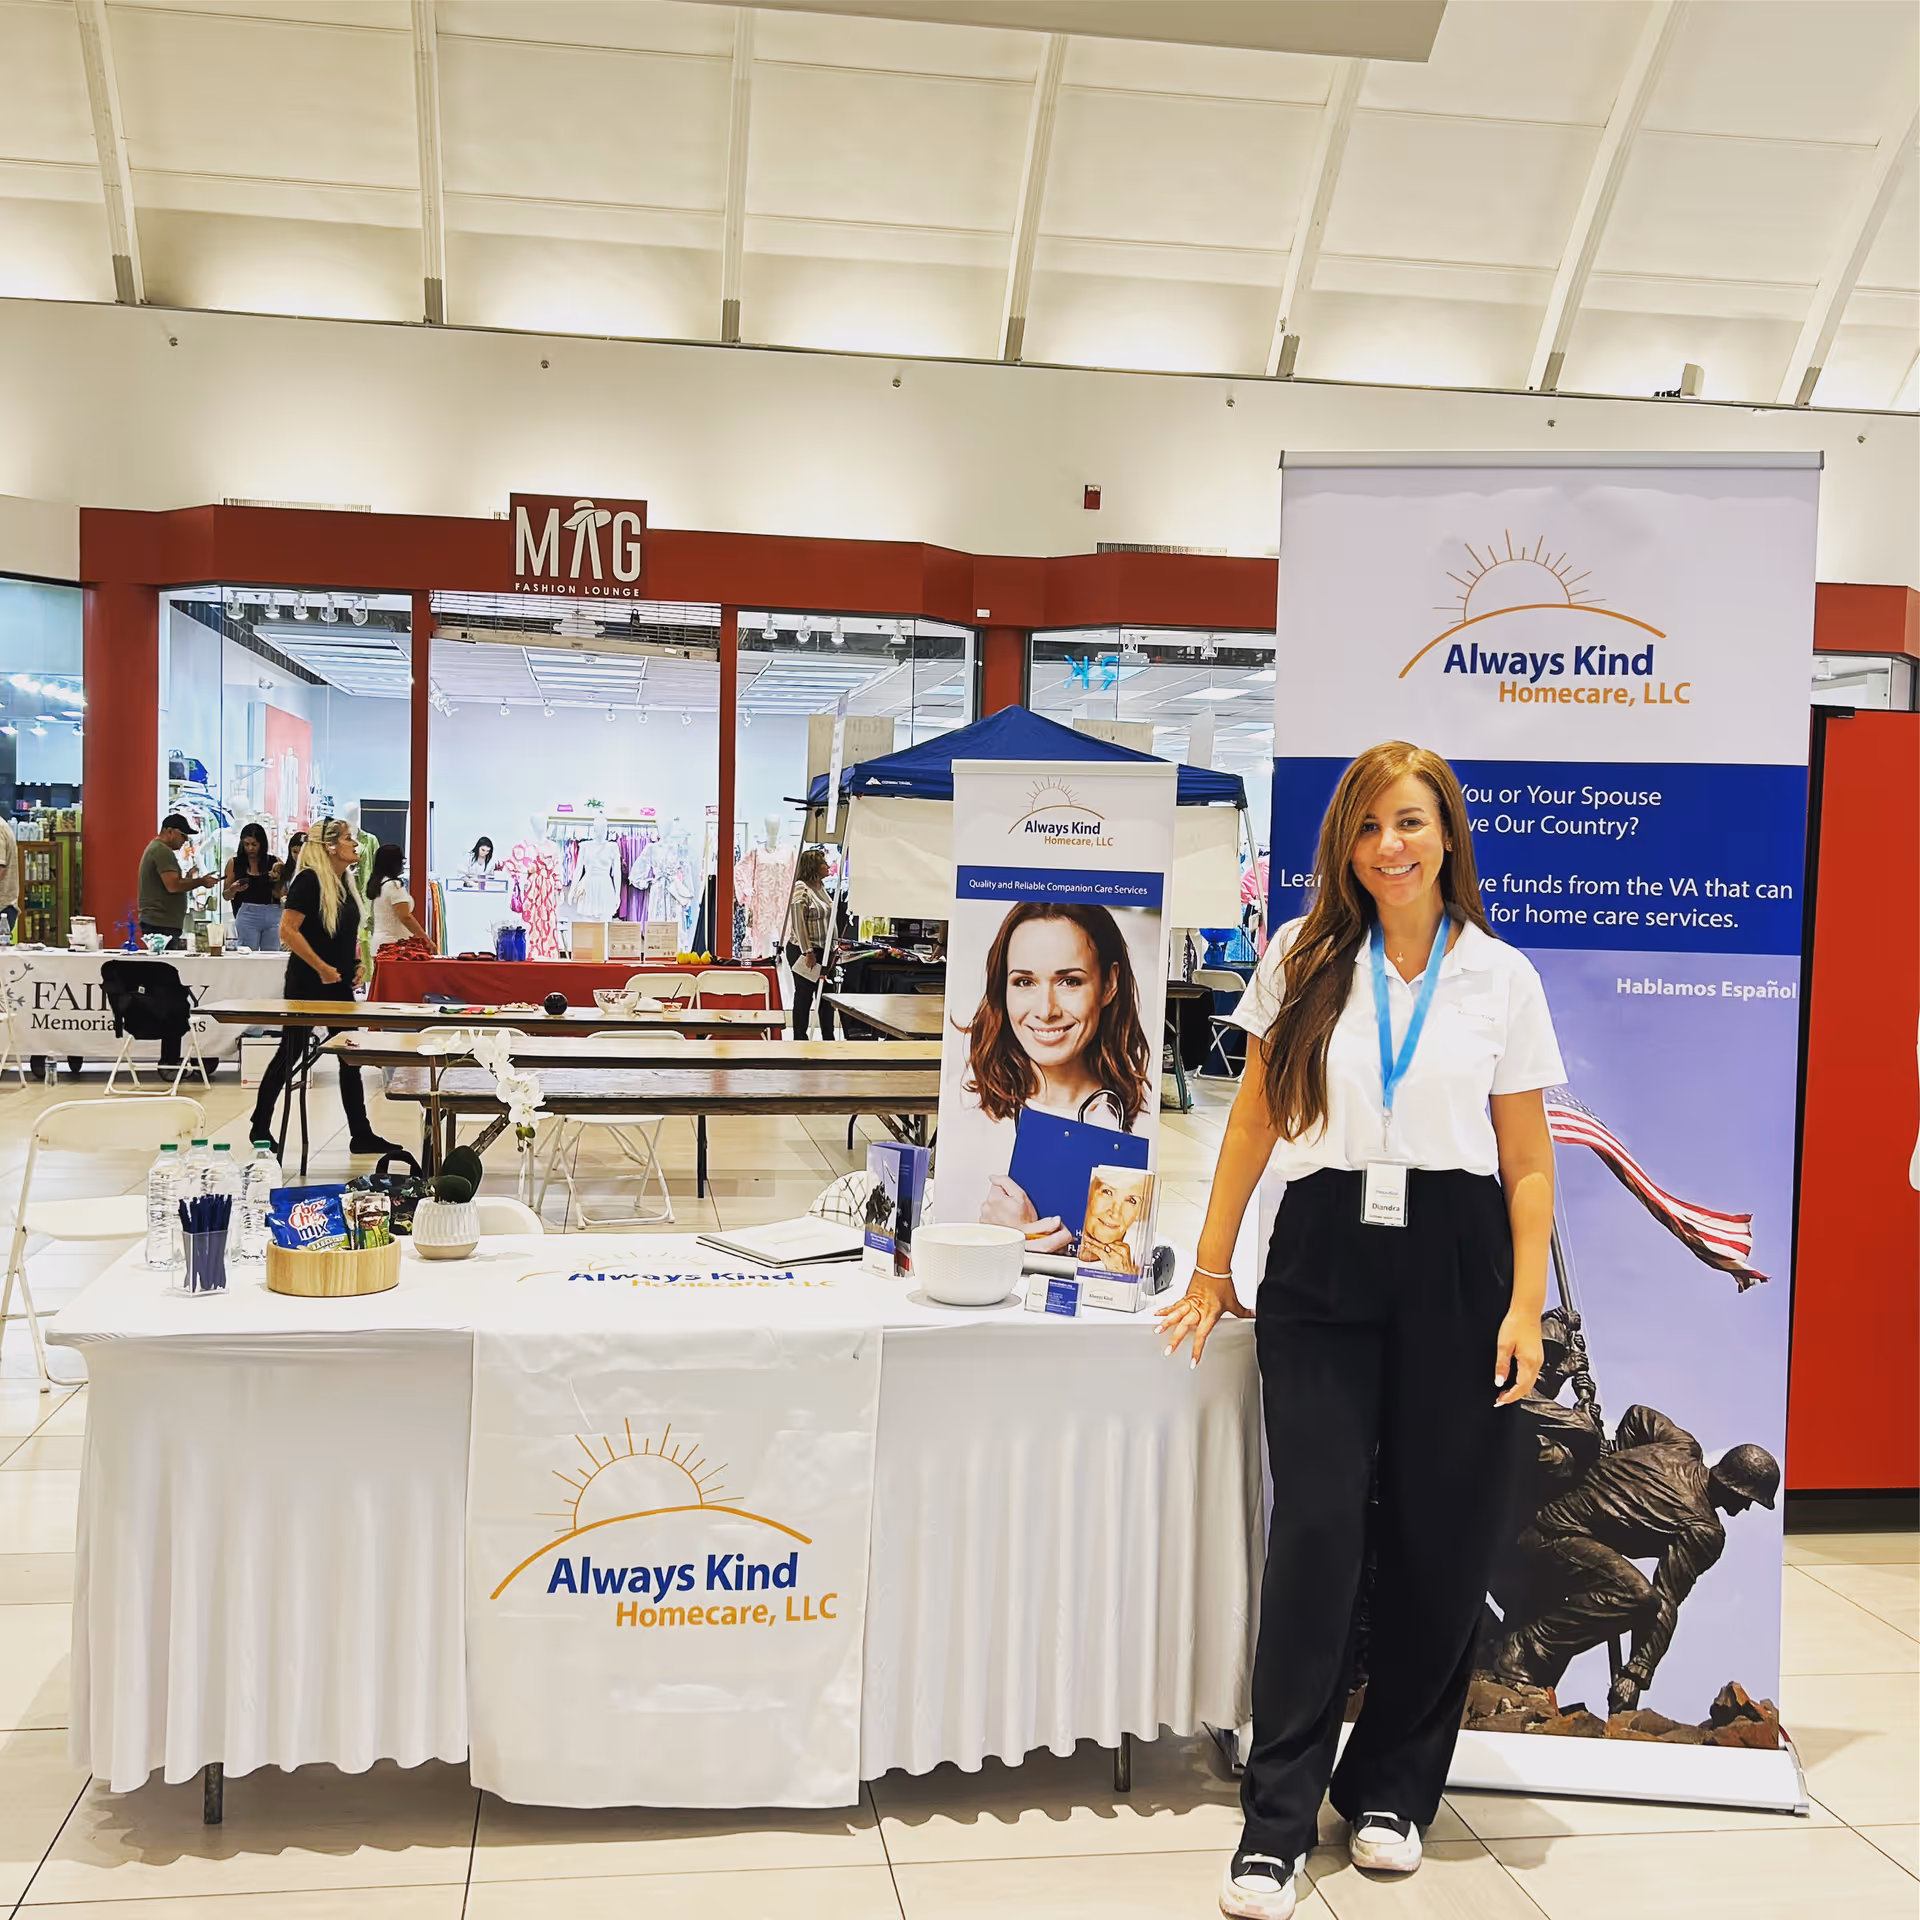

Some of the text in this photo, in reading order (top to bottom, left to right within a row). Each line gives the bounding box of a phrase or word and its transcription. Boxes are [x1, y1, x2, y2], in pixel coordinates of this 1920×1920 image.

[515, 500, 641, 582] MAG
[515, 583, 640, 597] FASHION LOUNGE
[1443, 643, 1654, 684] Always Kind
[1499, 681, 1691, 707] Homecare, LLC
[1499, 789, 1522, 804] or
[1527, 785, 1576, 805] Your
[1581, 786, 1662, 809] Spouse
[1024, 820, 1101, 836] Always Kind
[1495, 814, 1536, 834] Our
[1540, 815, 1640, 840] Country?
[1044, 836, 1114, 847] Homecare, LLC
[969, 879, 1148, 895] Quality and Reliable Companion Care Services
[1503, 873, 1563, 894] funds
[1568, 875, 1620, 895] from
[1627, 876, 1663, 896] the
[1669, 878, 1699, 897] VA
[1705, 878, 1750, 899] that
[1755, 883, 1793, 899] can
[1490, 903, 1520, 923] for
[1525, 904, 1588, 924] home
[1593, 909, 1639, 926] care
[1645, 909, 1739, 928] services.
[1617, 978, 1797, 1001] Hablamos Español
[31, 1013, 116, 1031] Memoria
[568, 1272, 795, 1283] Always Kind
[547, 1552, 799, 1604] Always Kind
[616, 1593, 838, 1627] Homecare, LLC
